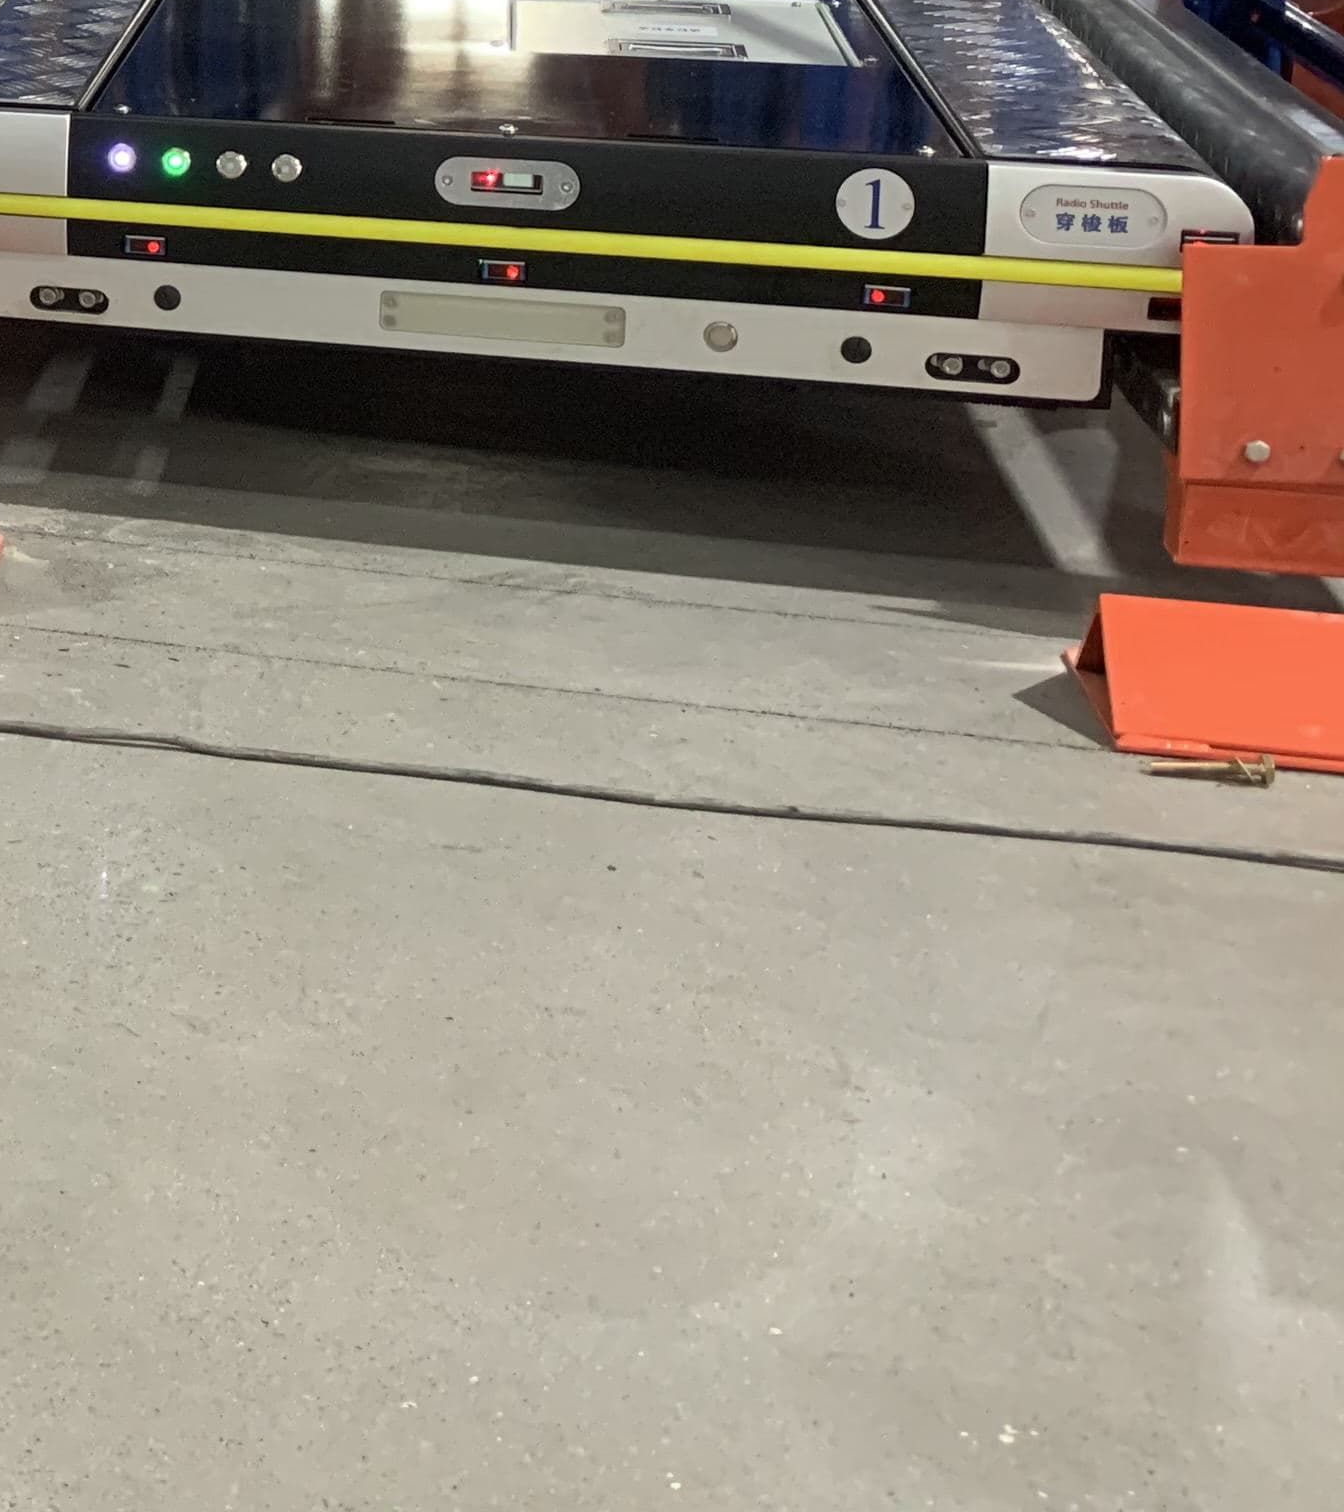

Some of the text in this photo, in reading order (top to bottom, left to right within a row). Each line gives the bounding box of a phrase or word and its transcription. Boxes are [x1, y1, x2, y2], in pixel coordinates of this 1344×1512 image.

[864, 179, 885, 230] 1
[1056, 198, 1129, 210] Radio Shuttle
[1055, 212, 1129, 233] 穿梭板
